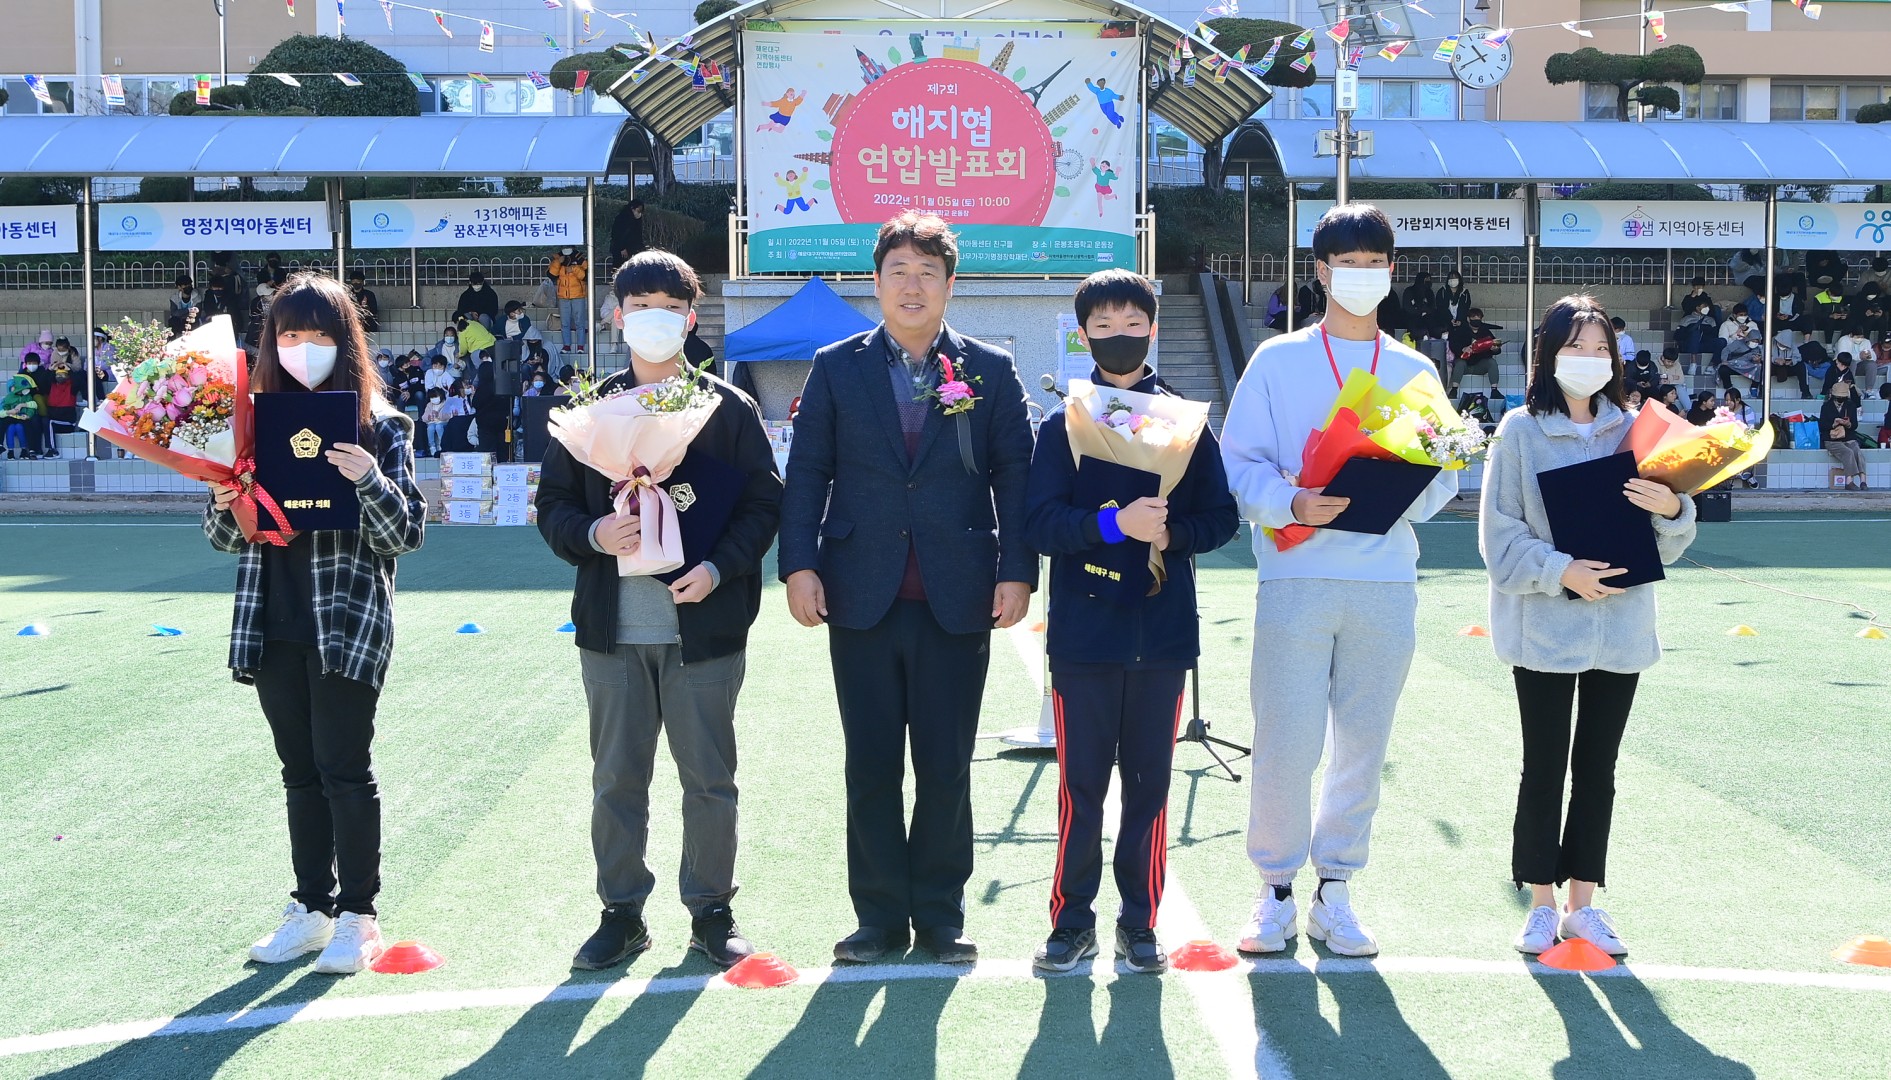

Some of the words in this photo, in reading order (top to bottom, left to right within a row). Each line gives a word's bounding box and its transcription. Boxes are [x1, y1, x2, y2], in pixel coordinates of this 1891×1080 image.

[756, 54, 792, 62] 지역아동센터
[1456, 54, 1461, 62] 9
[1500, 54, 1506, 62] 3
[1478, 75, 1484, 83] 6
[927, 82, 958, 96] 제7회
[892, 104, 992, 147] 해지협
[857, 143, 1026, 186] 연합발표회
[874, 194, 910, 205] 2022년
[914, 195, 934, 206] 11월
[937, 196, 959, 206] 05일
[961, 198, 975, 207] (토)
[978, 196, 1010, 206] 10:00
[474, 206, 548, 221] 1318해피존
[182, 217, 312, 236] 명정지역아동센터
[1397, 217, 1510, 231] 가람뫼지역아동센터
[1624, 220, 1654, 236] 꿈샘
[1659, 220, 1744, 236] 지역아동센터
[454, 222, 568, 238] 꿈&꾼지역아동센터
[768, 238, 774, 246] 일
[848, 238, 860, 246] (토)
[462, 461, 474, 470] 3등
[506, 472, 519, 482] 2등
[462, 485, 474, 494] 3등
[507, 494, 520, 502] 2등
[283, 500, 314, 509] 해운대구
[315, 500, 331, 508] 의회
[459, 510, 472, 518] 3등
[506, 515, 519, 523] 2등
[1084, 563, 1108, 577] 해운대구
[1108, 571, 1120, 581] 의회
